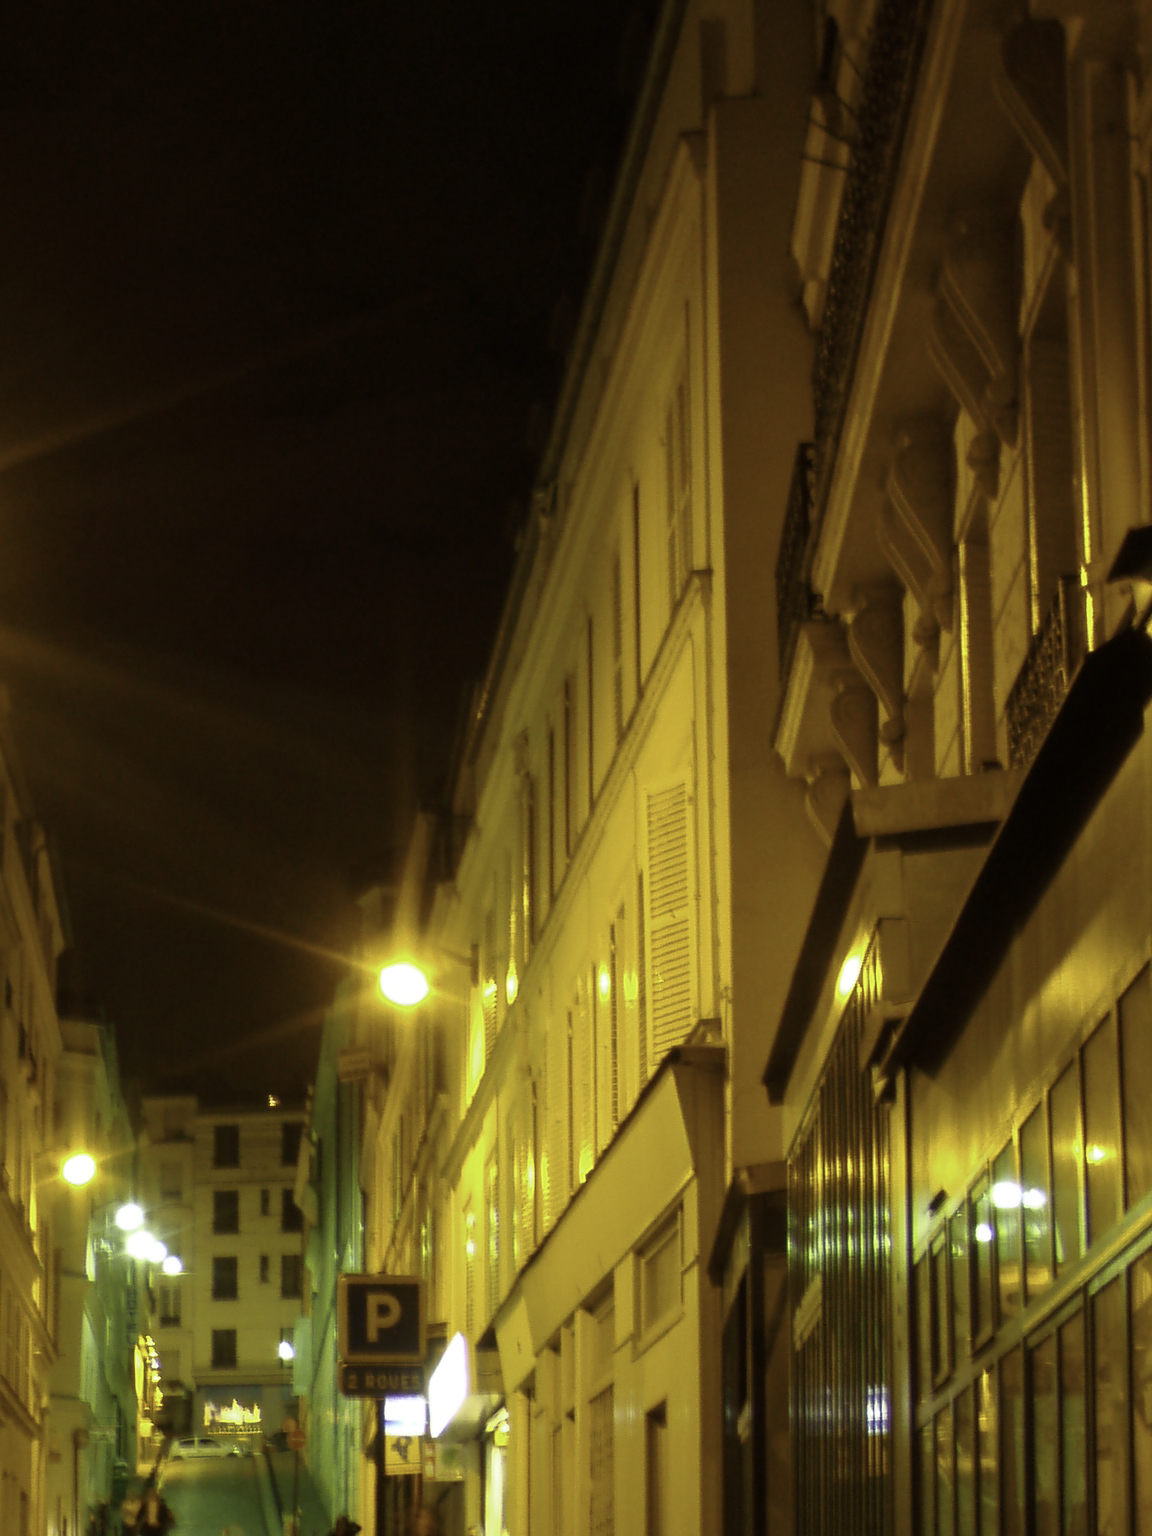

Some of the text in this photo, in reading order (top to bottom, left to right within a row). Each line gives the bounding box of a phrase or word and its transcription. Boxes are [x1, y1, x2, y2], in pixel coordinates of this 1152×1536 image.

[366, 1291, 402, 1343] P
[348, 1373, 422, 1391] 2 ROUES
